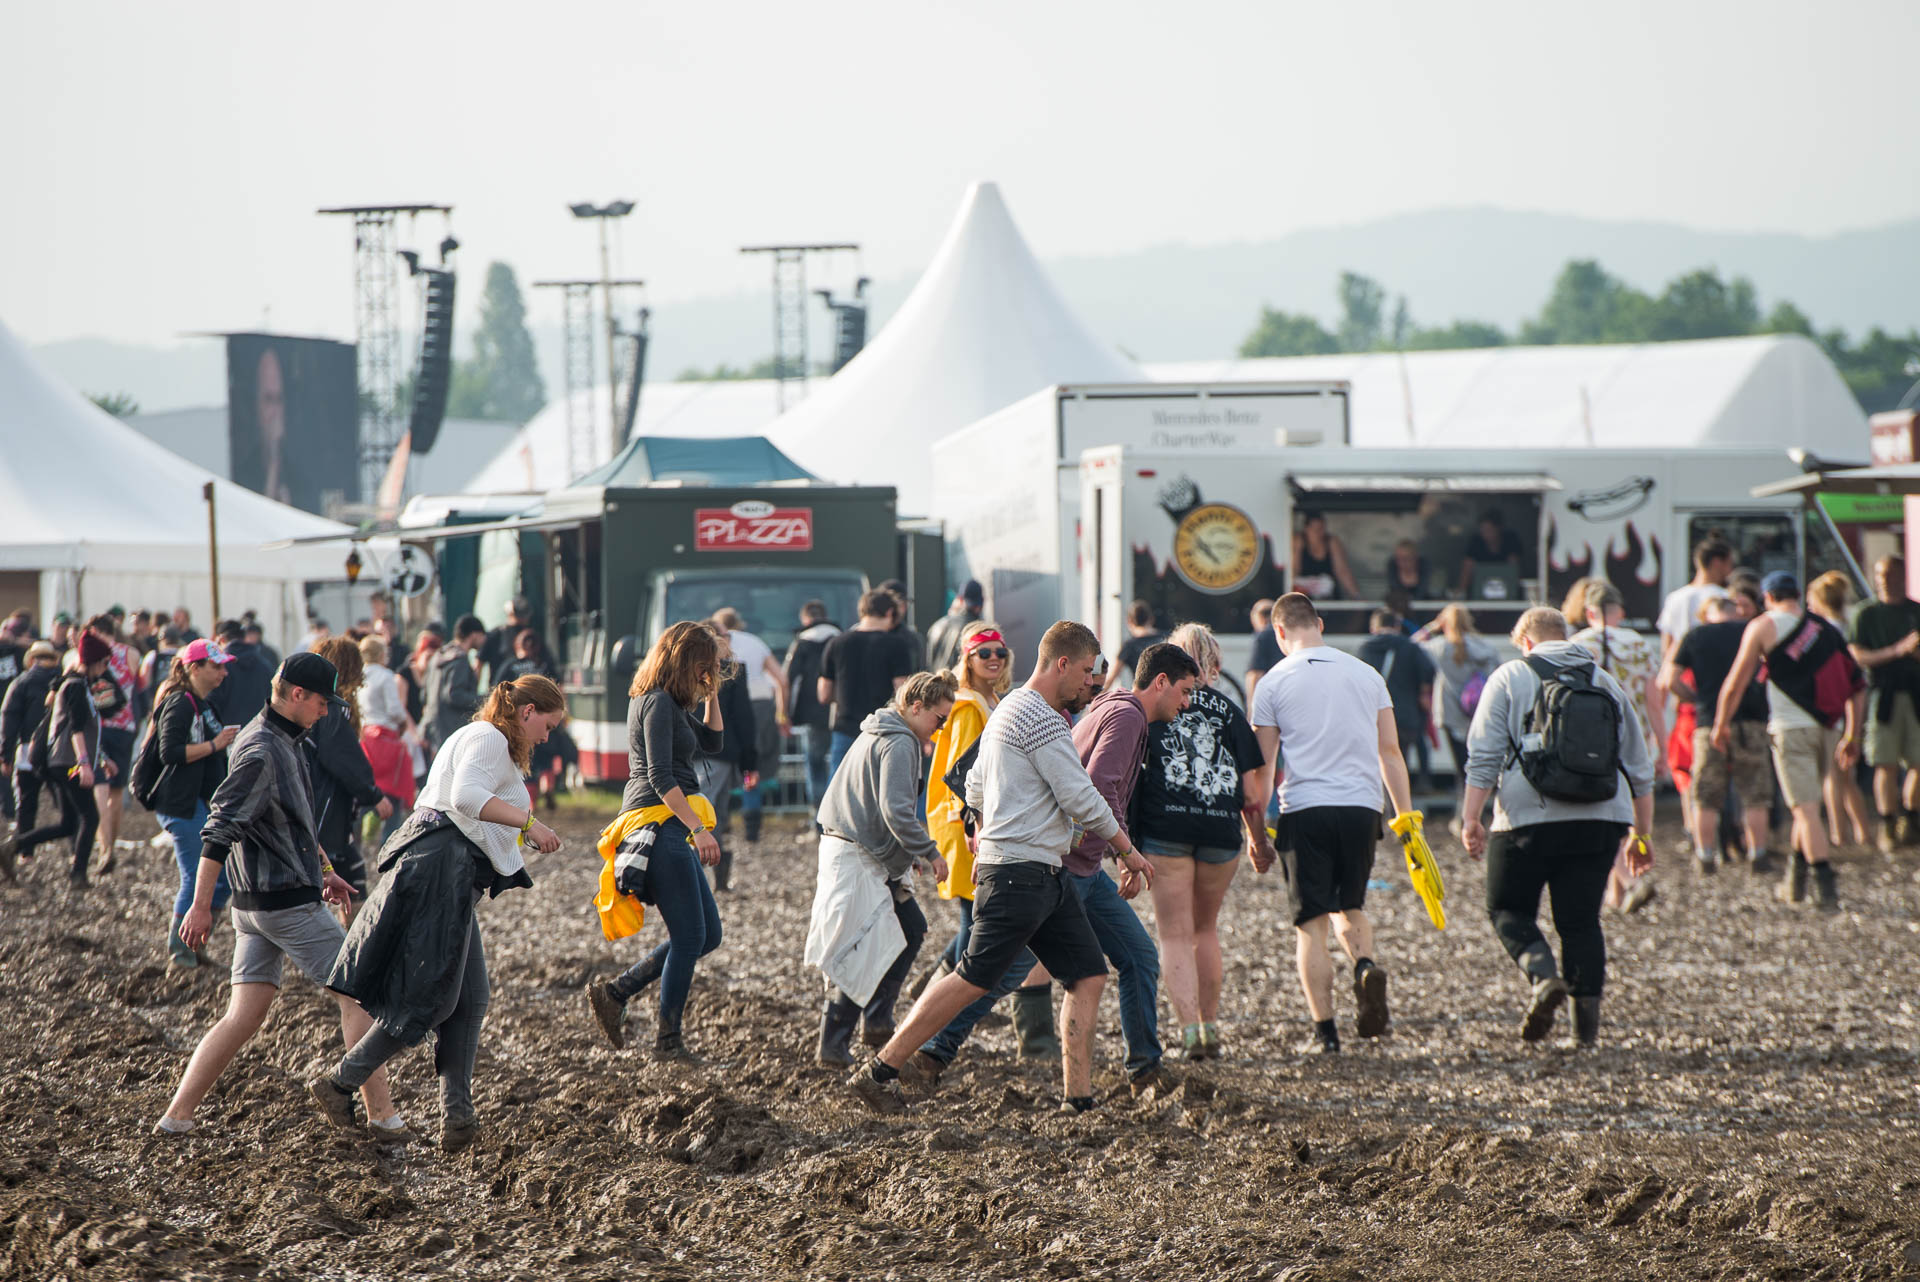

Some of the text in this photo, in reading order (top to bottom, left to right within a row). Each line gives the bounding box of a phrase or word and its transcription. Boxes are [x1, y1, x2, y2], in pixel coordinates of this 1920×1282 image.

[700, 518, 809, 545] PIZZA
[1165, 804, 1187, 813] DOWN
[1190, 806, 1203, 815] BUT
